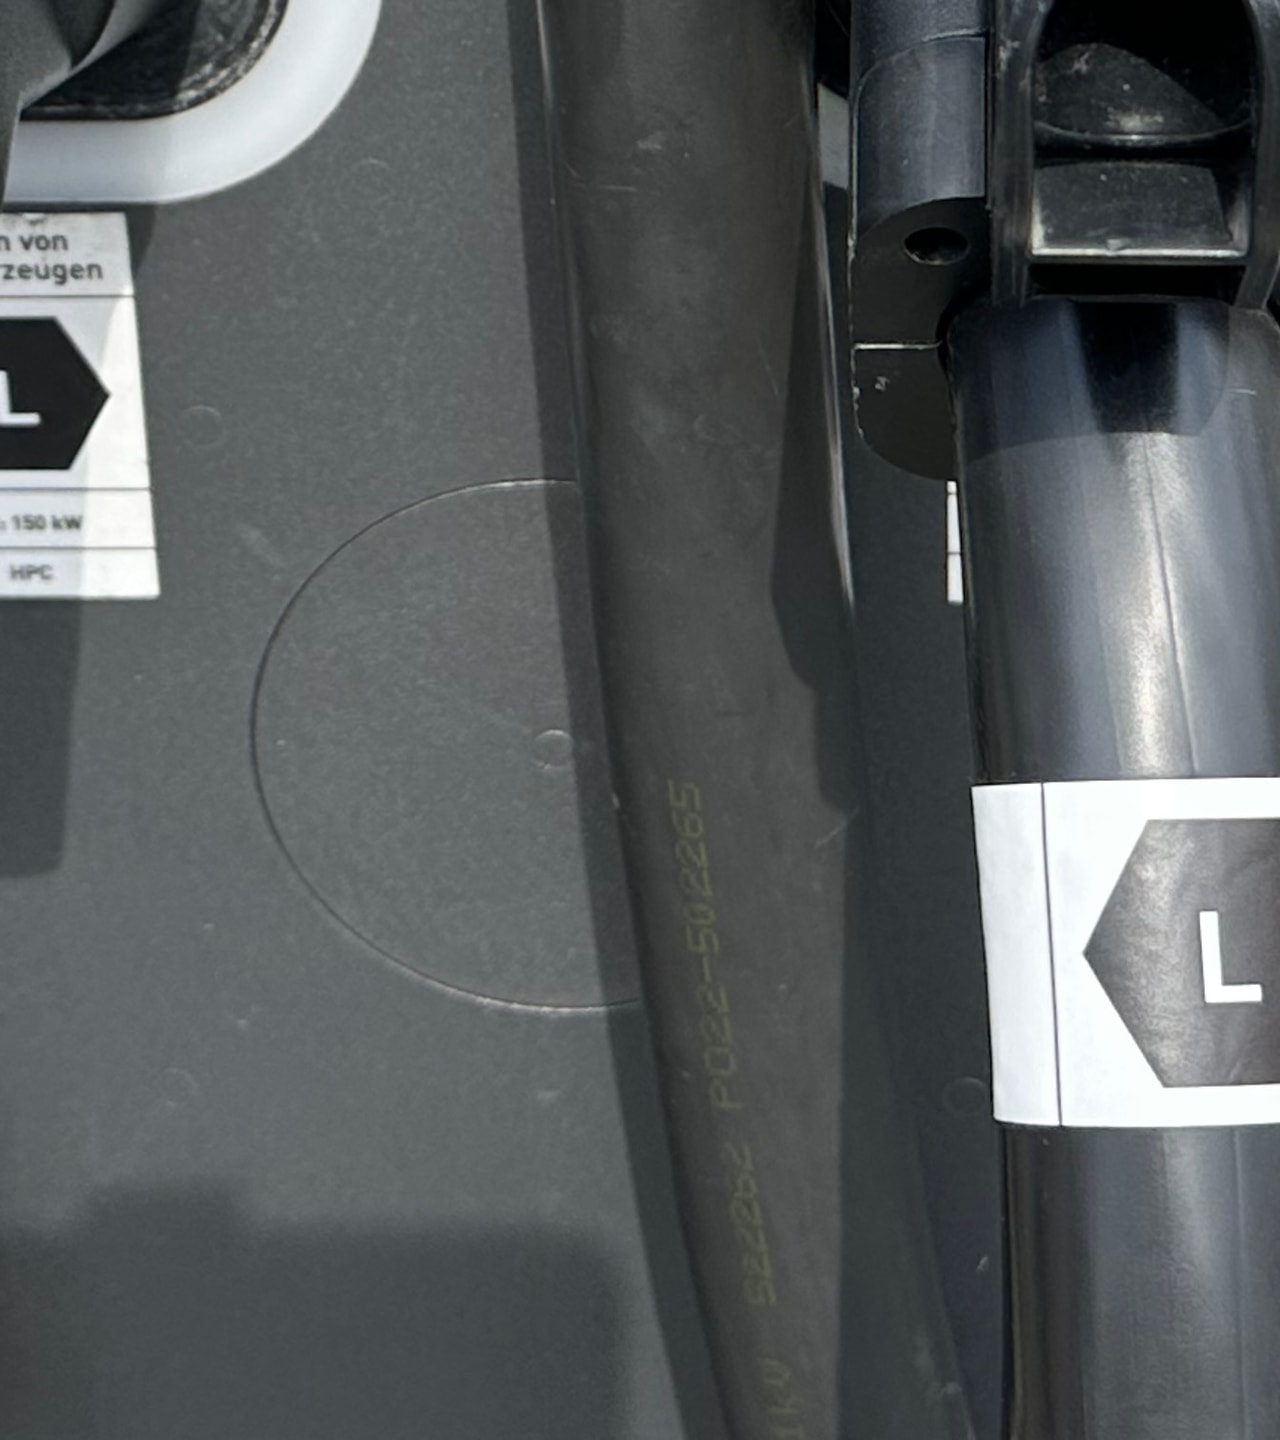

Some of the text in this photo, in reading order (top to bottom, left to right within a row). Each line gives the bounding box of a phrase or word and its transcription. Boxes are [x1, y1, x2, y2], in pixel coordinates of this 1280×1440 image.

[18, 234, 69, 252] von
[11, 513, 47, 531] 150
[51, 513, 84, 531] kW
[9, 563, 54, 581] HPC
[1198, 910, 1262, 1004] L
